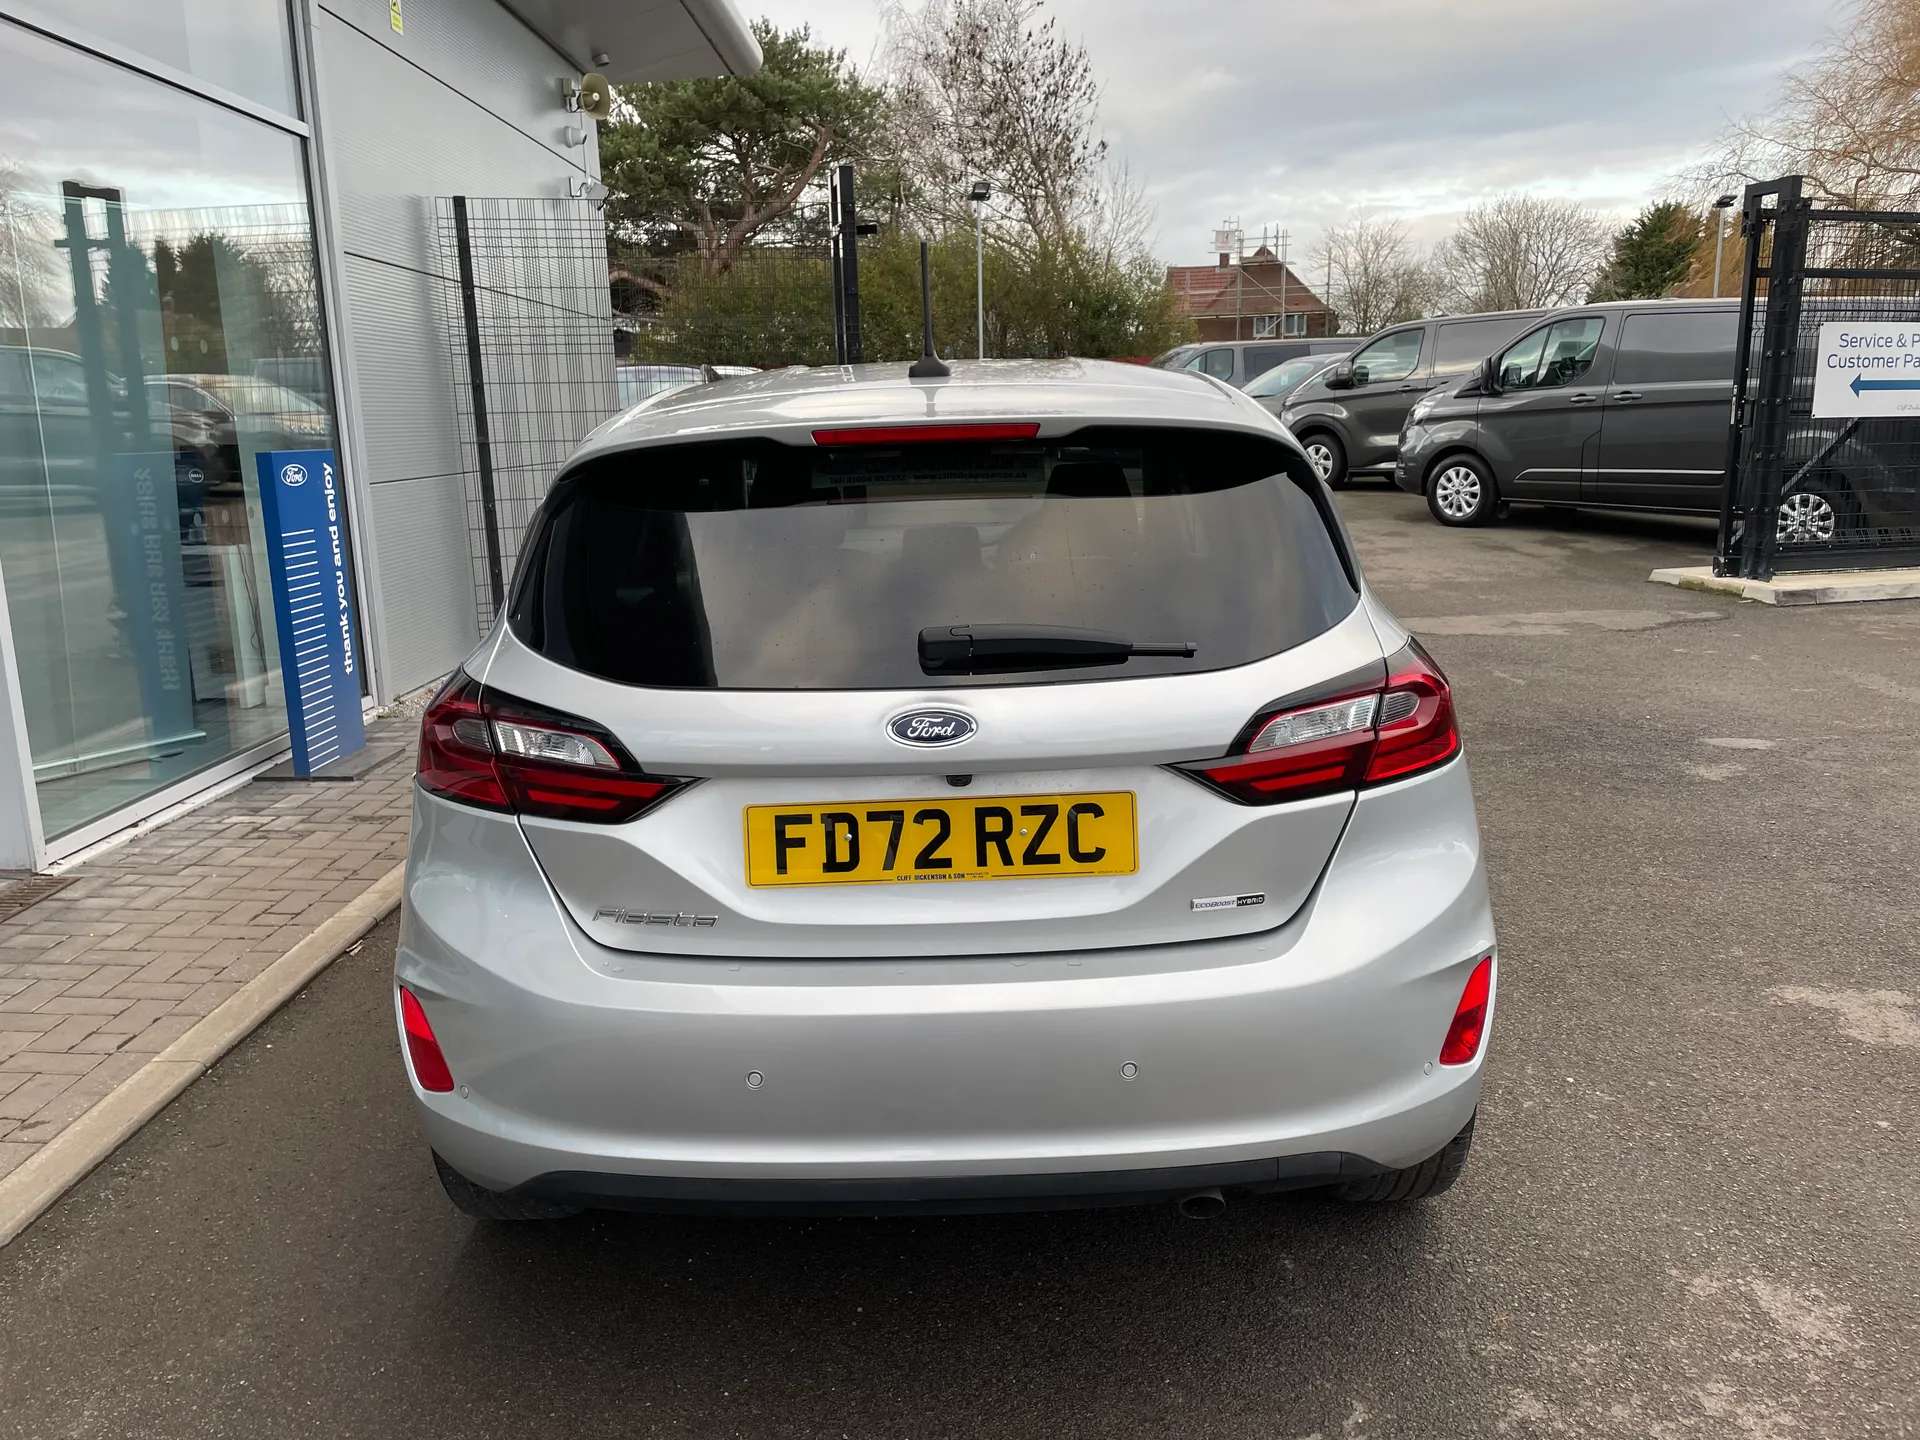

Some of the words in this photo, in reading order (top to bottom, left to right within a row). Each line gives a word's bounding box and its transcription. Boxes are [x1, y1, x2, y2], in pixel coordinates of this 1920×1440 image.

[1839, 332, 1893, 348] Service
[1896, 332, 1908, 348] &
[1827, 353, 1900, 369] Customer
[285, 466, 304, 483] Ford
[323, 462, 337, 522] enjoy
[328, 525, 342, 567] and
[336, 571, 348, 610] you
[340, 612, 353, 675] thank
[907, 717, 956, 738] Ford
[774, 807, 953, 875] FD72
[974, 802, 1107, 868] RZC
